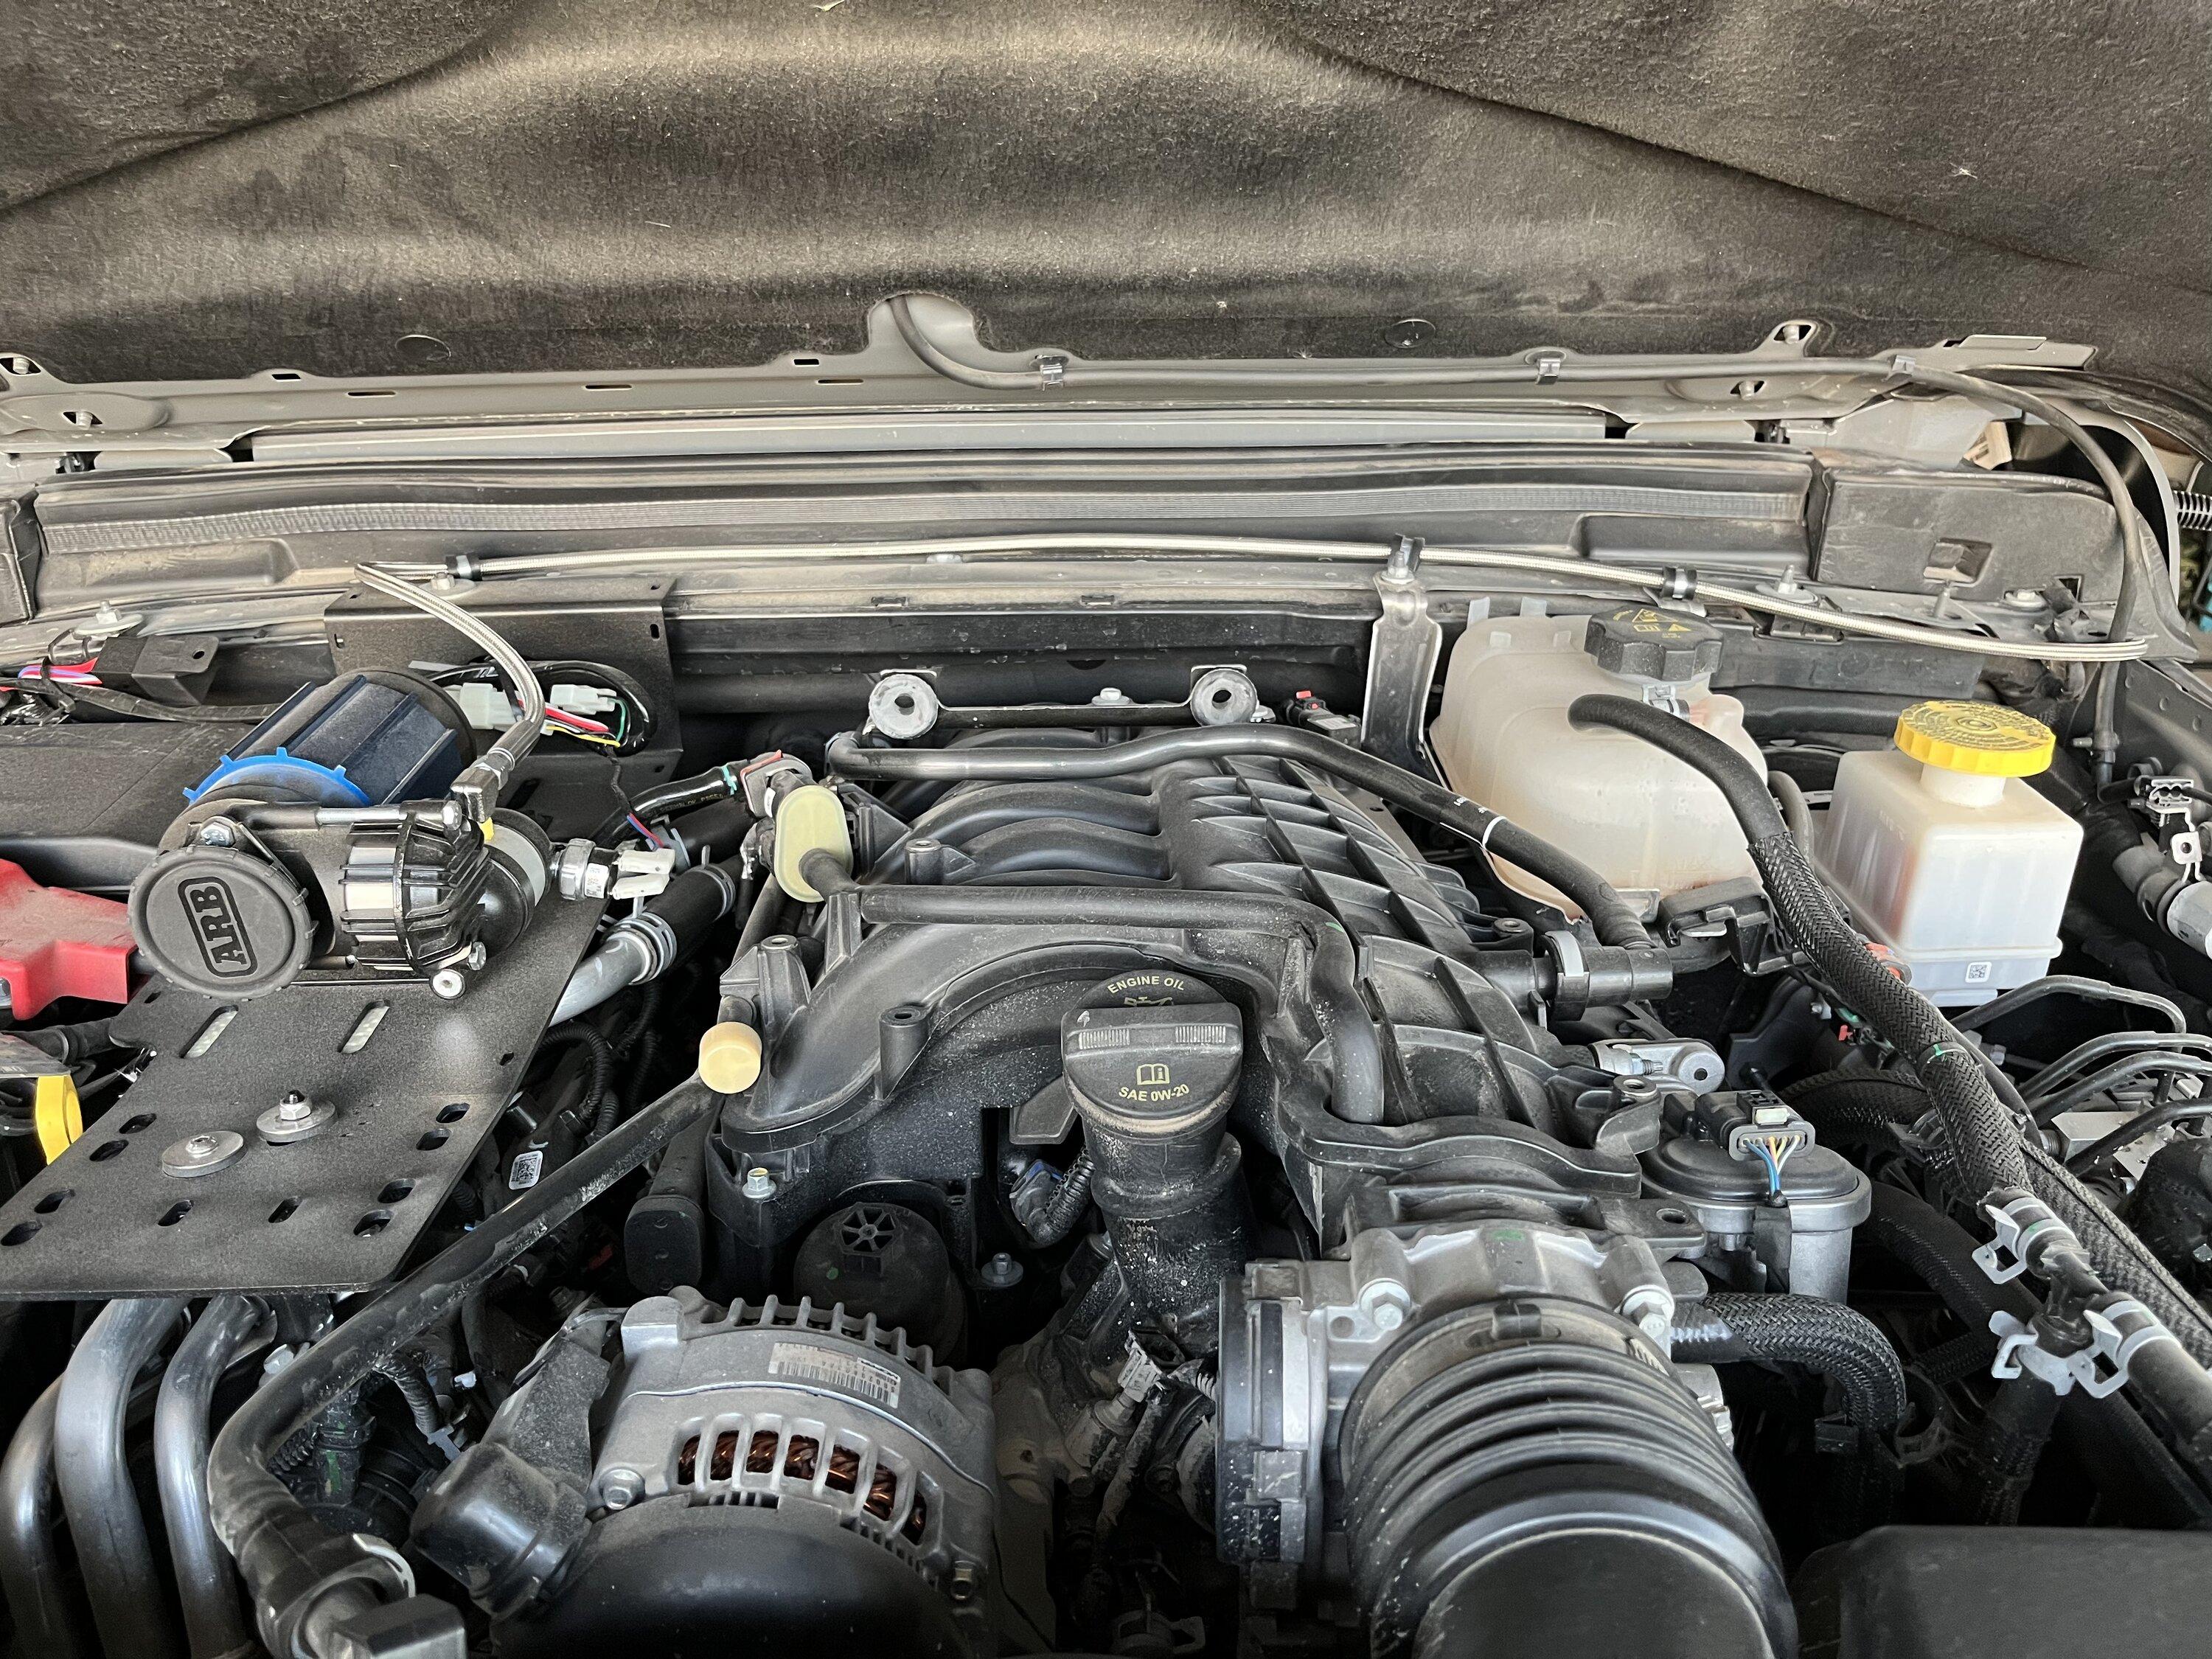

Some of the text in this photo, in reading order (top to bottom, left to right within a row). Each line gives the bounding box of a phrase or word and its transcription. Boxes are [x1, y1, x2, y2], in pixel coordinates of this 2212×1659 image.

[189, 886, 248, 965] ARB
[1107, 975, 1185, 993] ENGINE OIL
[1119, 1084, 1189, 1102] SAE 0W-20
